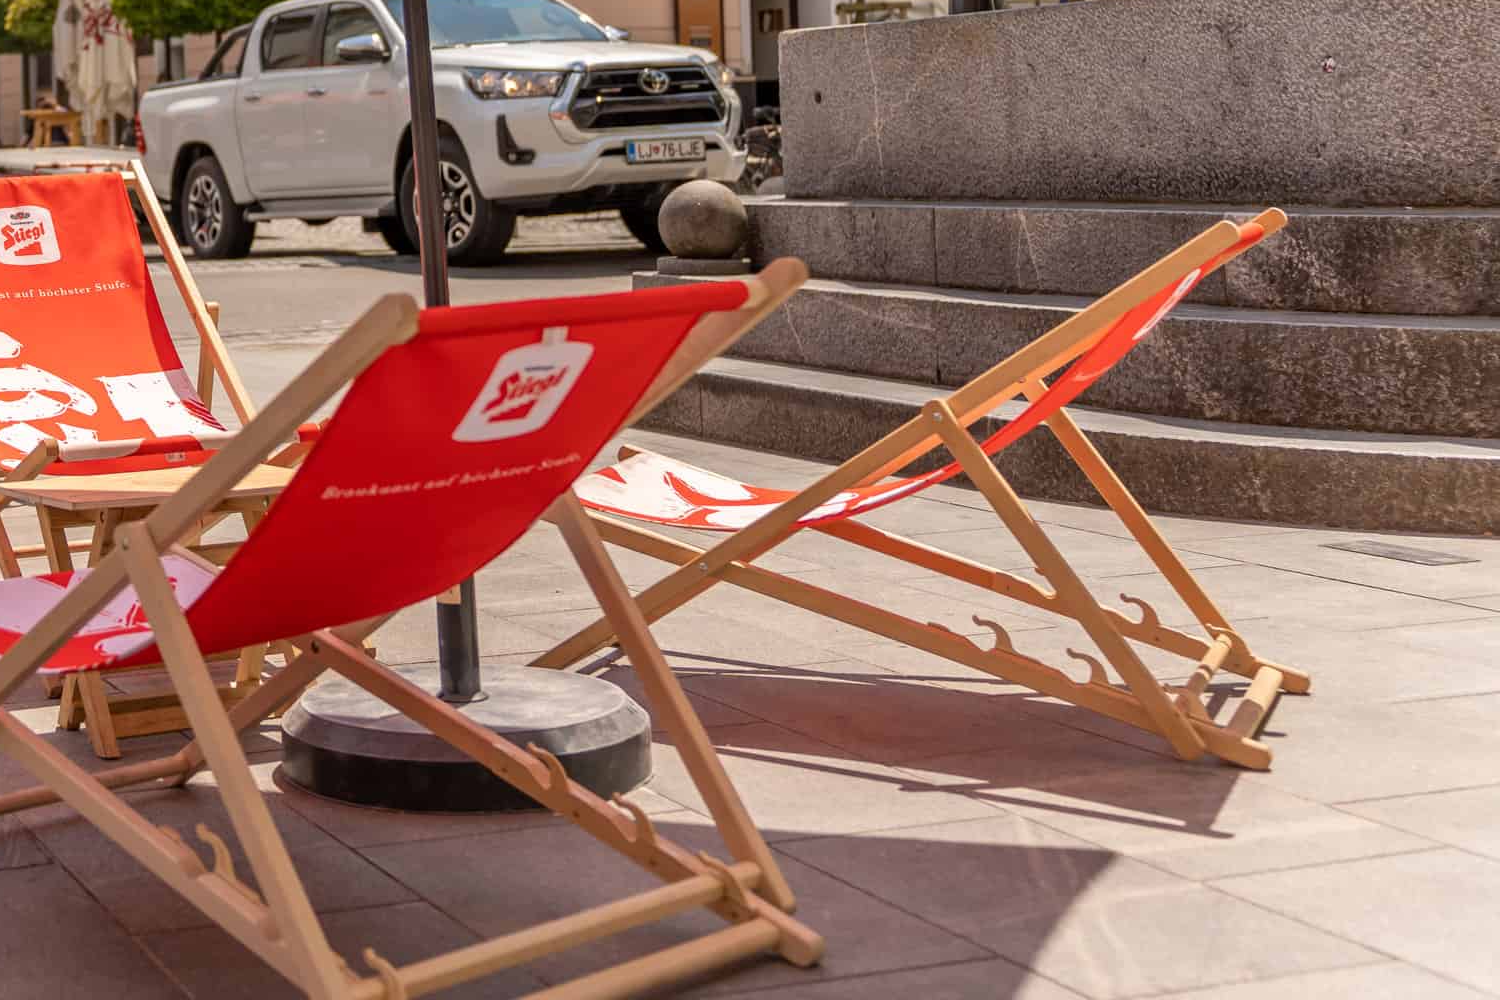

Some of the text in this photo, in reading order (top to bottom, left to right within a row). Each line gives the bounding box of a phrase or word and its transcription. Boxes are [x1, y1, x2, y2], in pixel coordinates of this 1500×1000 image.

[1, 221, 46, 251] Stiegl
[14, 289, 35, 299] auf
[39, 285, 92, 297] höchster
[95, 279, 131, 292] Stufe.
